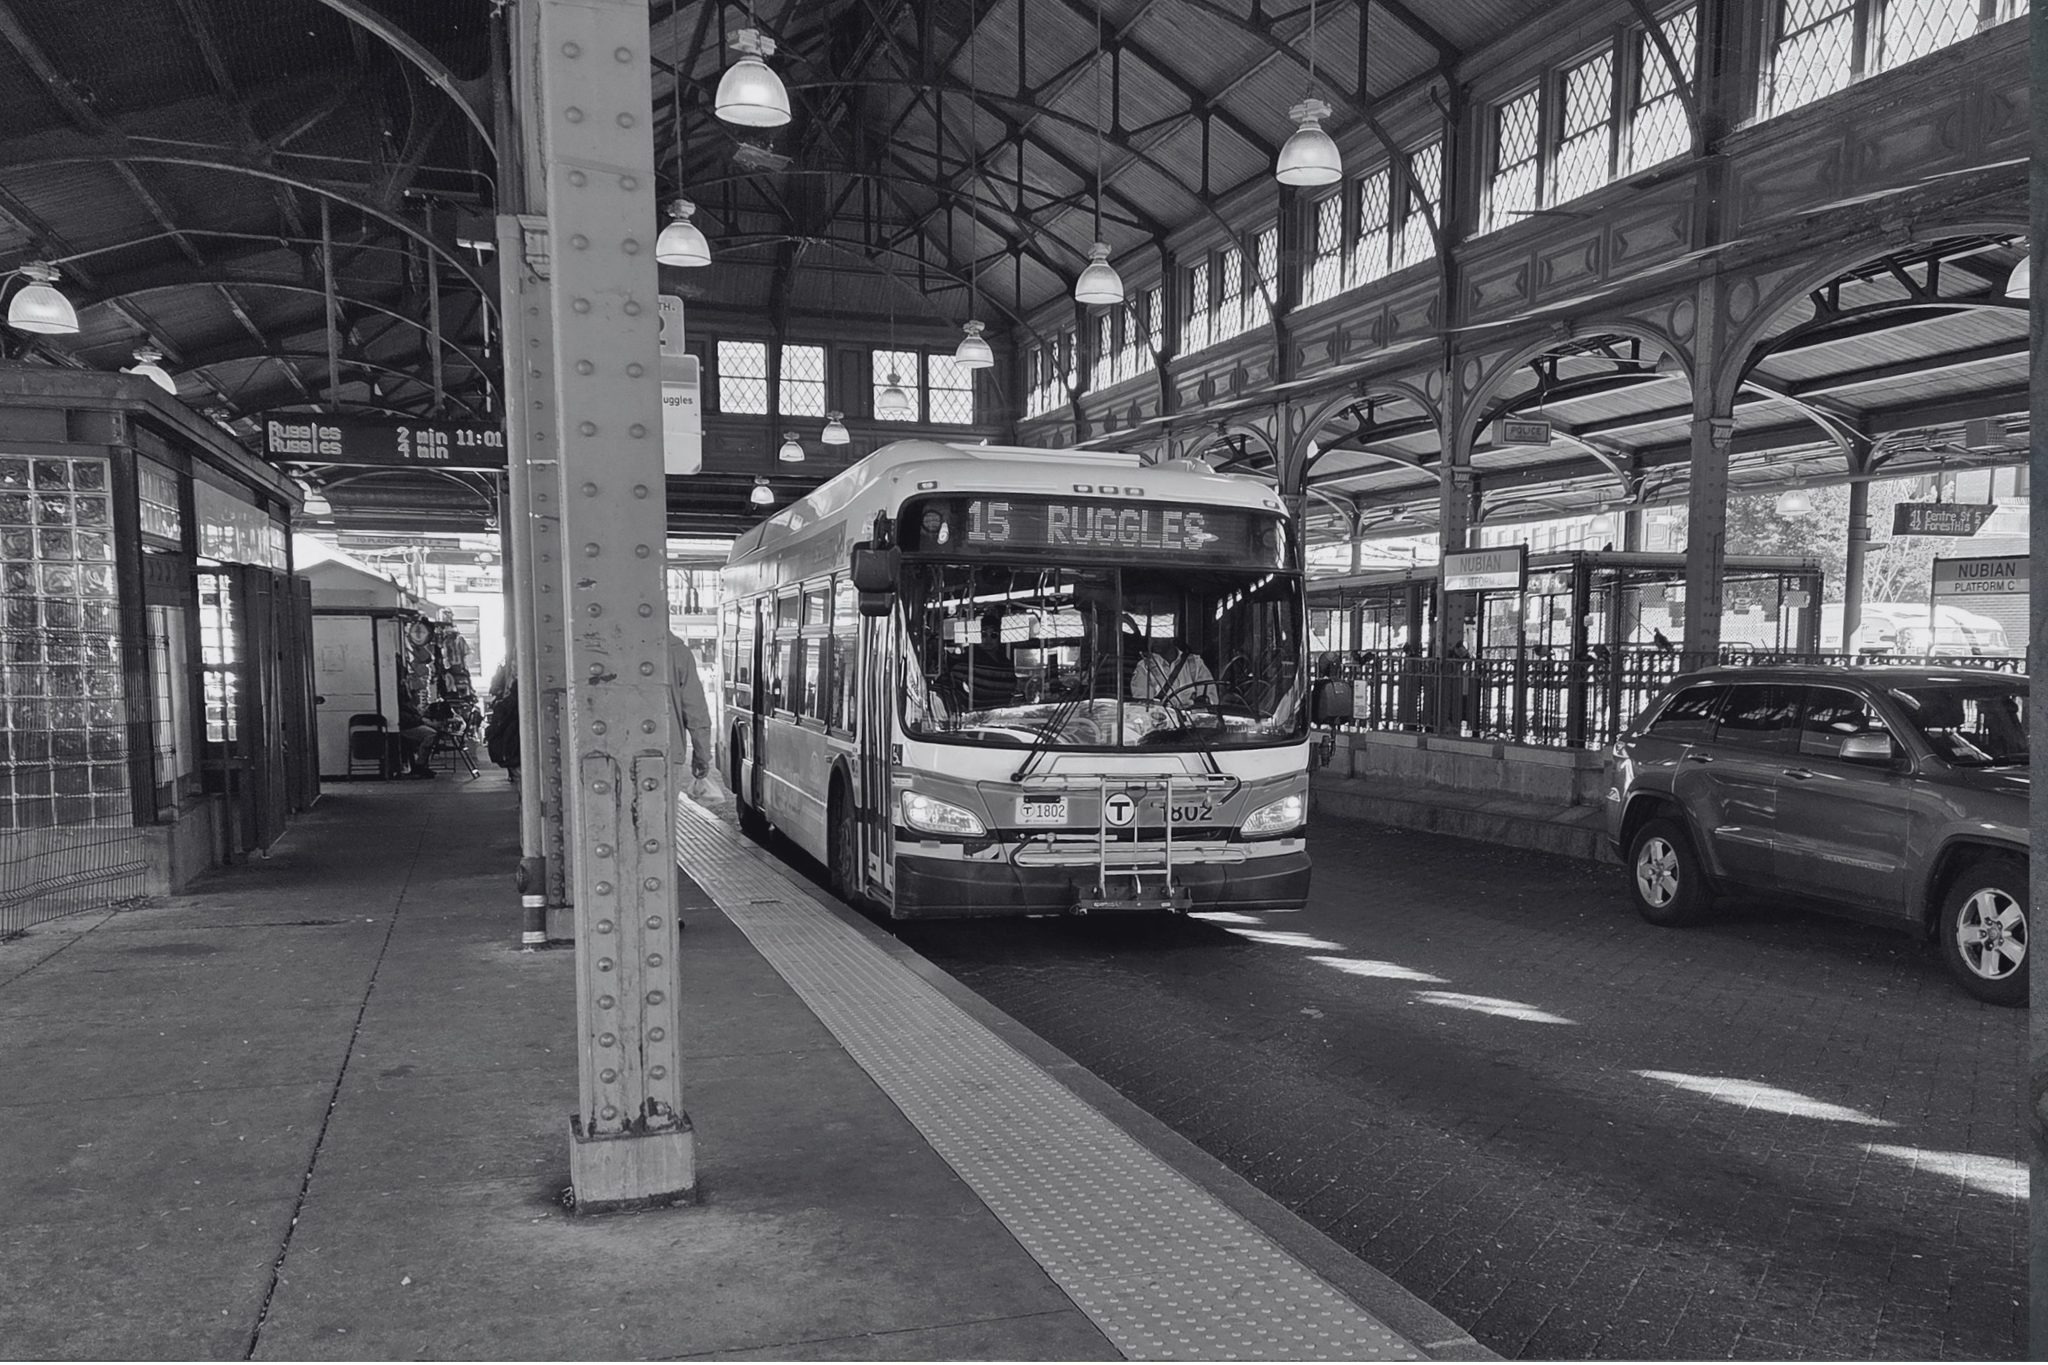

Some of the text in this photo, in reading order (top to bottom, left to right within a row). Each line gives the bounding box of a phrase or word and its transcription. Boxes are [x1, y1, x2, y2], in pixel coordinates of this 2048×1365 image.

[663, 395, 693, 406] uggles
[268, 420, 504, 448] Ruggles 2 min 11:01
[1510, 426, 1542, 436] POLICE
[268, 436, 449, 459] Ruggles 4 min
[1910, 509, 1921, 521] 41
[1925, 510, 1957, 521] Centre
[1961, 511, 1971, 522] St
[968, 501, 1204, 550] 15 RUGGLES
[1910, 520, 1921, 531] 42
[1460, 556, 1502, 572] NUBIAN
[1958, 562, 2016, 578] NUBIAN
[1954, 580, 2015, 592] PLATFORM C
[1036, 804, 1066, 818] 1802
